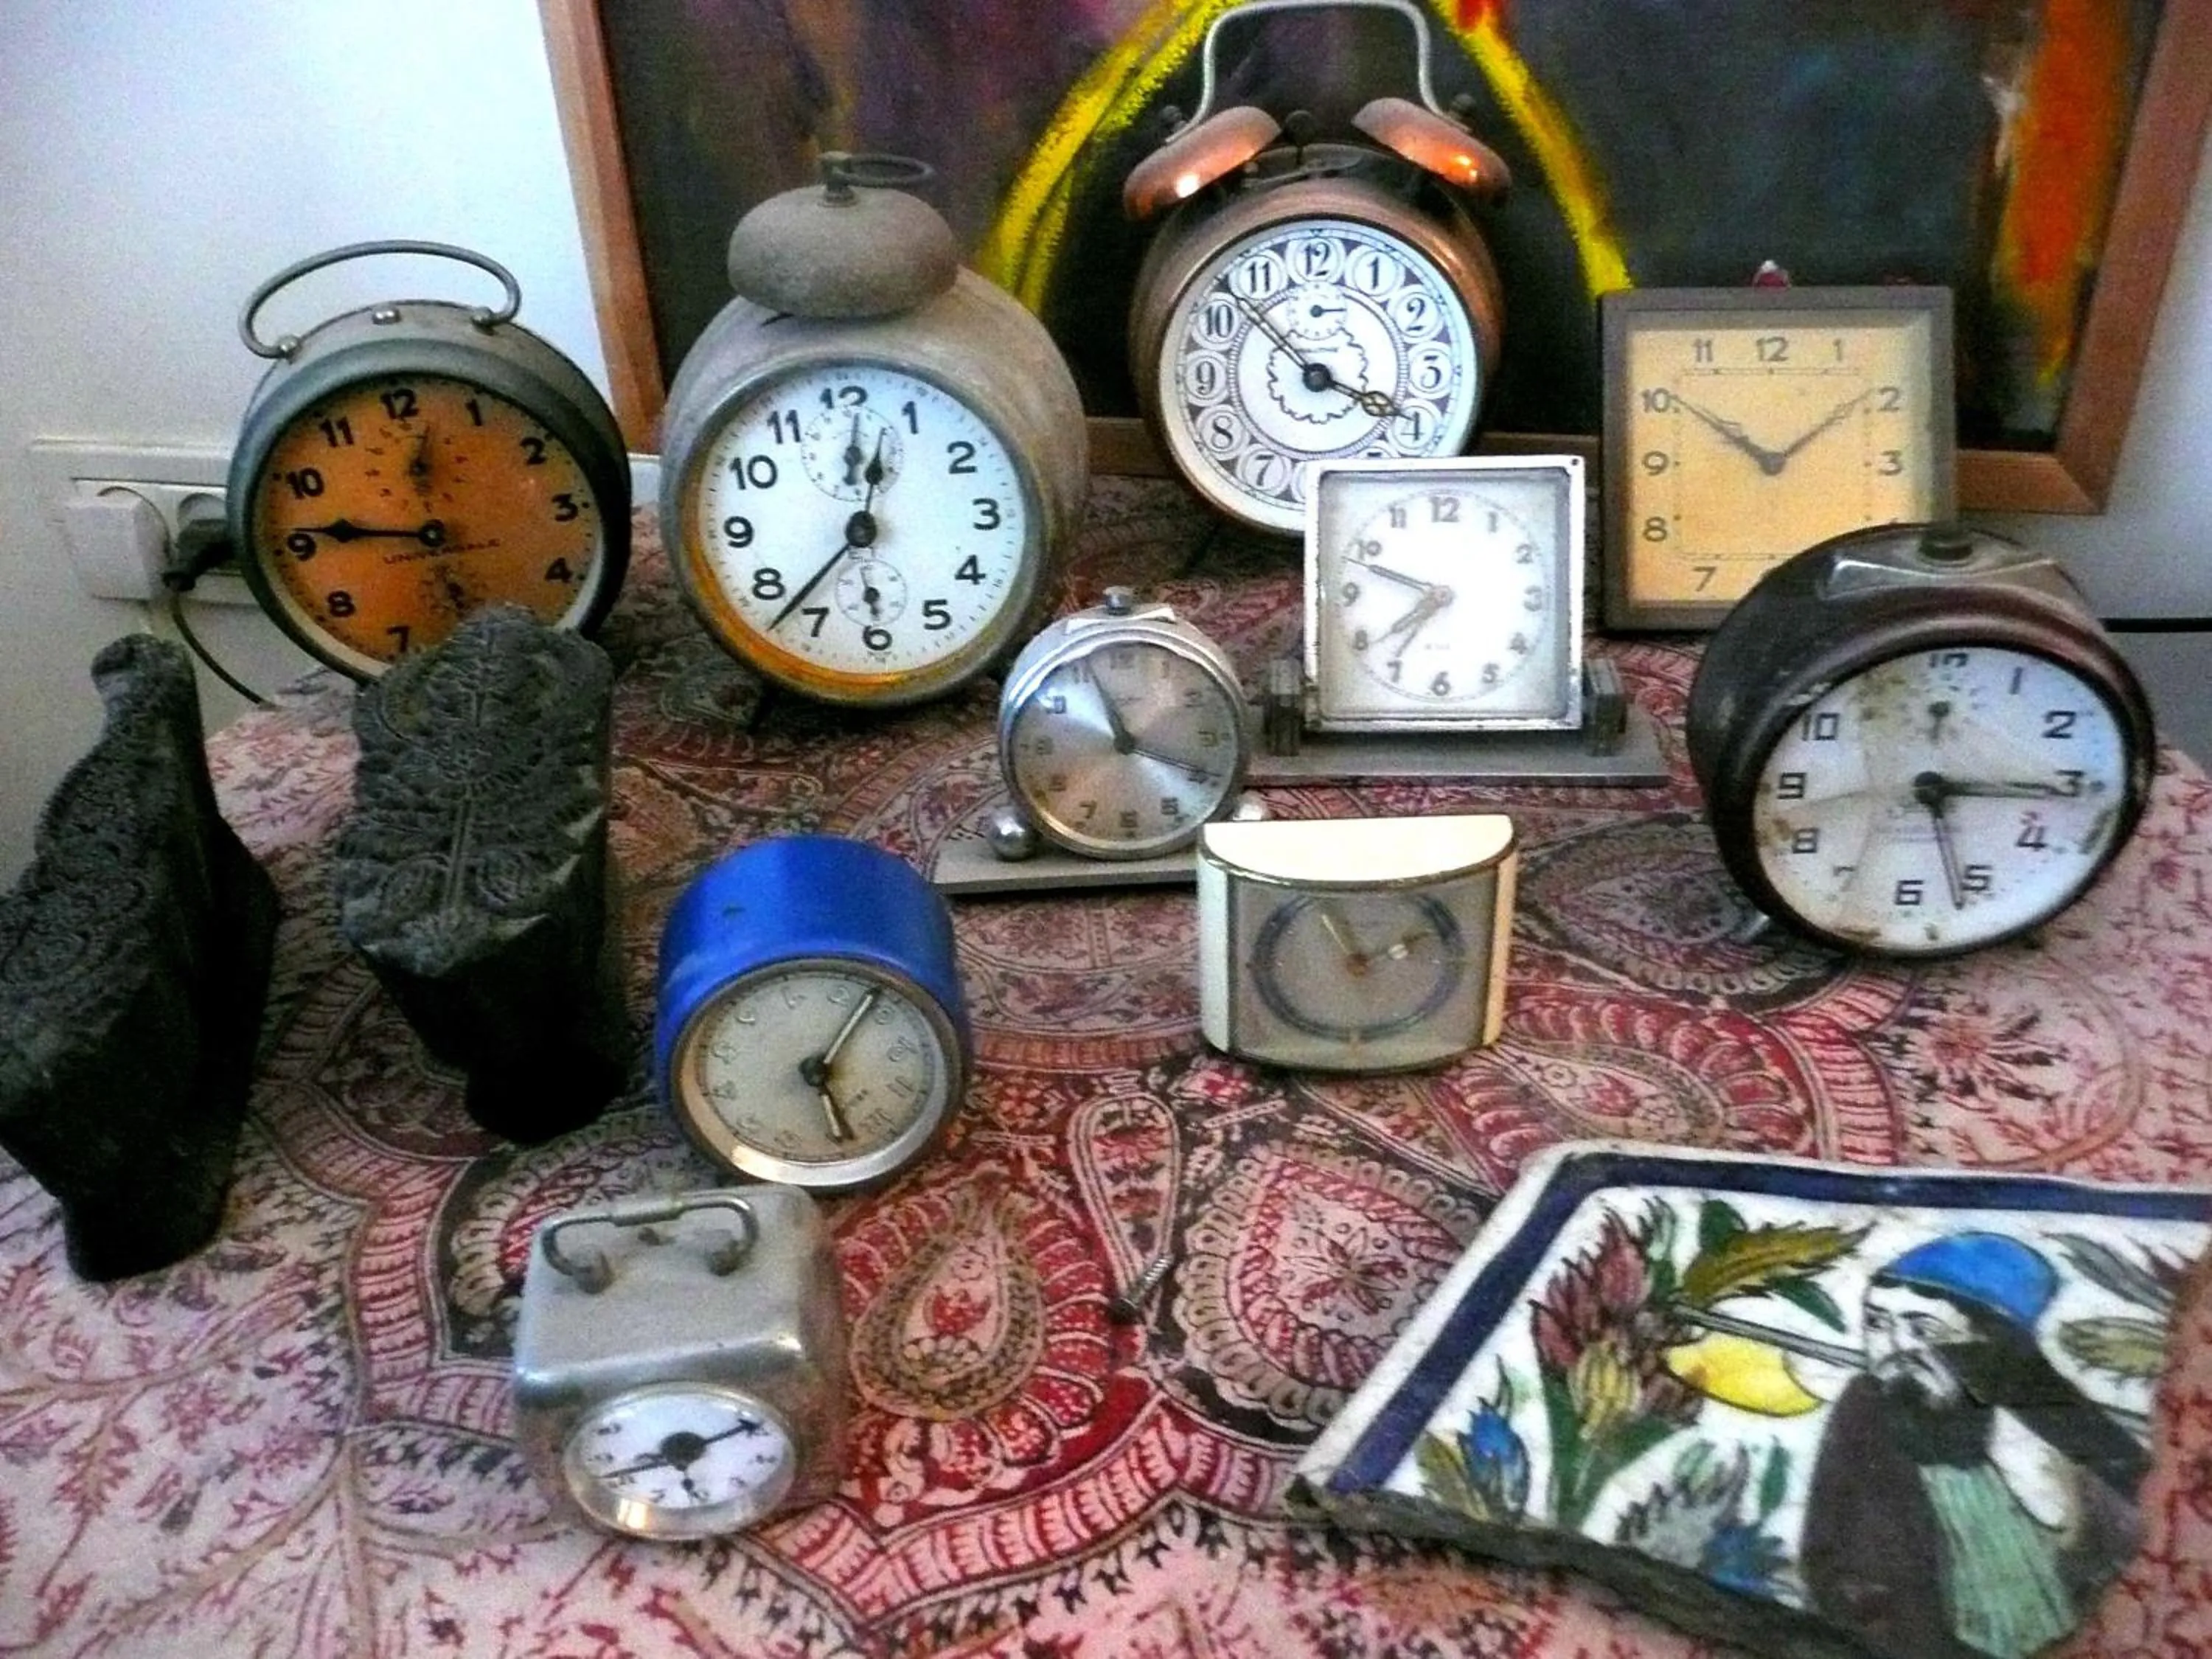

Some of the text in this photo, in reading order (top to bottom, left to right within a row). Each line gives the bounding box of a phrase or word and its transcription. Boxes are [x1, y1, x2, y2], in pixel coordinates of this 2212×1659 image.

[1304, 242, 1330, 276] 12
[1249, 262, 1271, 293] 11
[1366, 257, 1380, 290] 1
[1206, 305, 1234, 338] 10
[1407, 297, 1426, 331] 2
[1692, 338, 1714, 364] 11
[1756, 337, 1789, 362] 12
[1832, 338, 1843, 361] 1
[1195, 361, 1216, 394] 9
[1422, 355, 1441, 388] 3
[380, 389, 418, 420] 12
[819, 386, 867, 409] 12
[1641, 388, 1671, 414] 10
[1877, 386, 1900, 413] 2
[465, 400, 482, 425] 1
[902, 401, 919, 434] 1
[321, 417, 355, 448] 11
[767, 410, 800, 444] 11
[1211, 415, 1234, 448] 8
[1401, 411, 1425, 442] 4
[521, 437, 546, 465] 2
[947, 442, 978, 474] 2
[1642, 451, 1669, 476] 9
[1878, 450, 1905, 476] 3
[288, 468, 324, 499] 10
[728, 455, 778, 490] 10
[1256, 454, 1275, 486] 7
[552, 494, 578, 521] 3
[973, 498, 1001, 530] 3
[1388, 504, 1406, 529] 11
[1429, 496, 1461, 523] 12
[724, 516, 754, 549] 9
[1487, 512, 1499, 533] 1
[1643, 517, 1668, 543] 8
[288, 533, 316, 561] 9
[1349, 538, 1382, 560] 10
[1516, 543, 1534, 565] 2
[545, 557, 572, 583] 4
[955, 555, 986, 585] 4
[1694, 566, 1717, 592] 7
[751, 568, 786, 600] 8
[1341, 582, 1360, 607] 9
[327, 591, 355, 618] 8
[1524, 585, 1543, 612] 3
[802, 608, 830, 637] 7
[922, 599, 952, 630] 5
[387, 626, 409, 653] 7
[863, 625, 892, 651] 6
[1354, 630, 1368, 651] 8
[1508, 632, 1527, 655] 4
[1387, 660, 1402, 683] 7
[1430, 671, 1450, 696] 6
[1482, 663, 1500, 684] 5
[2010, 667, 2023, 695] 1
[1802, 712, 1840, 741] 10
[2042, 711, 2076, 739] 2
[1777, 772, 1807, 800] 9
[2056, 771, 2084, 799] 3
[1080, 801, 1097, 819] 7
[1792, 828, 1820, 854] 8
[2016, 826, 2047, 852] 4
[1961, 864, 1992, 891] 5
[1895, 880, 1923, 906] 6
